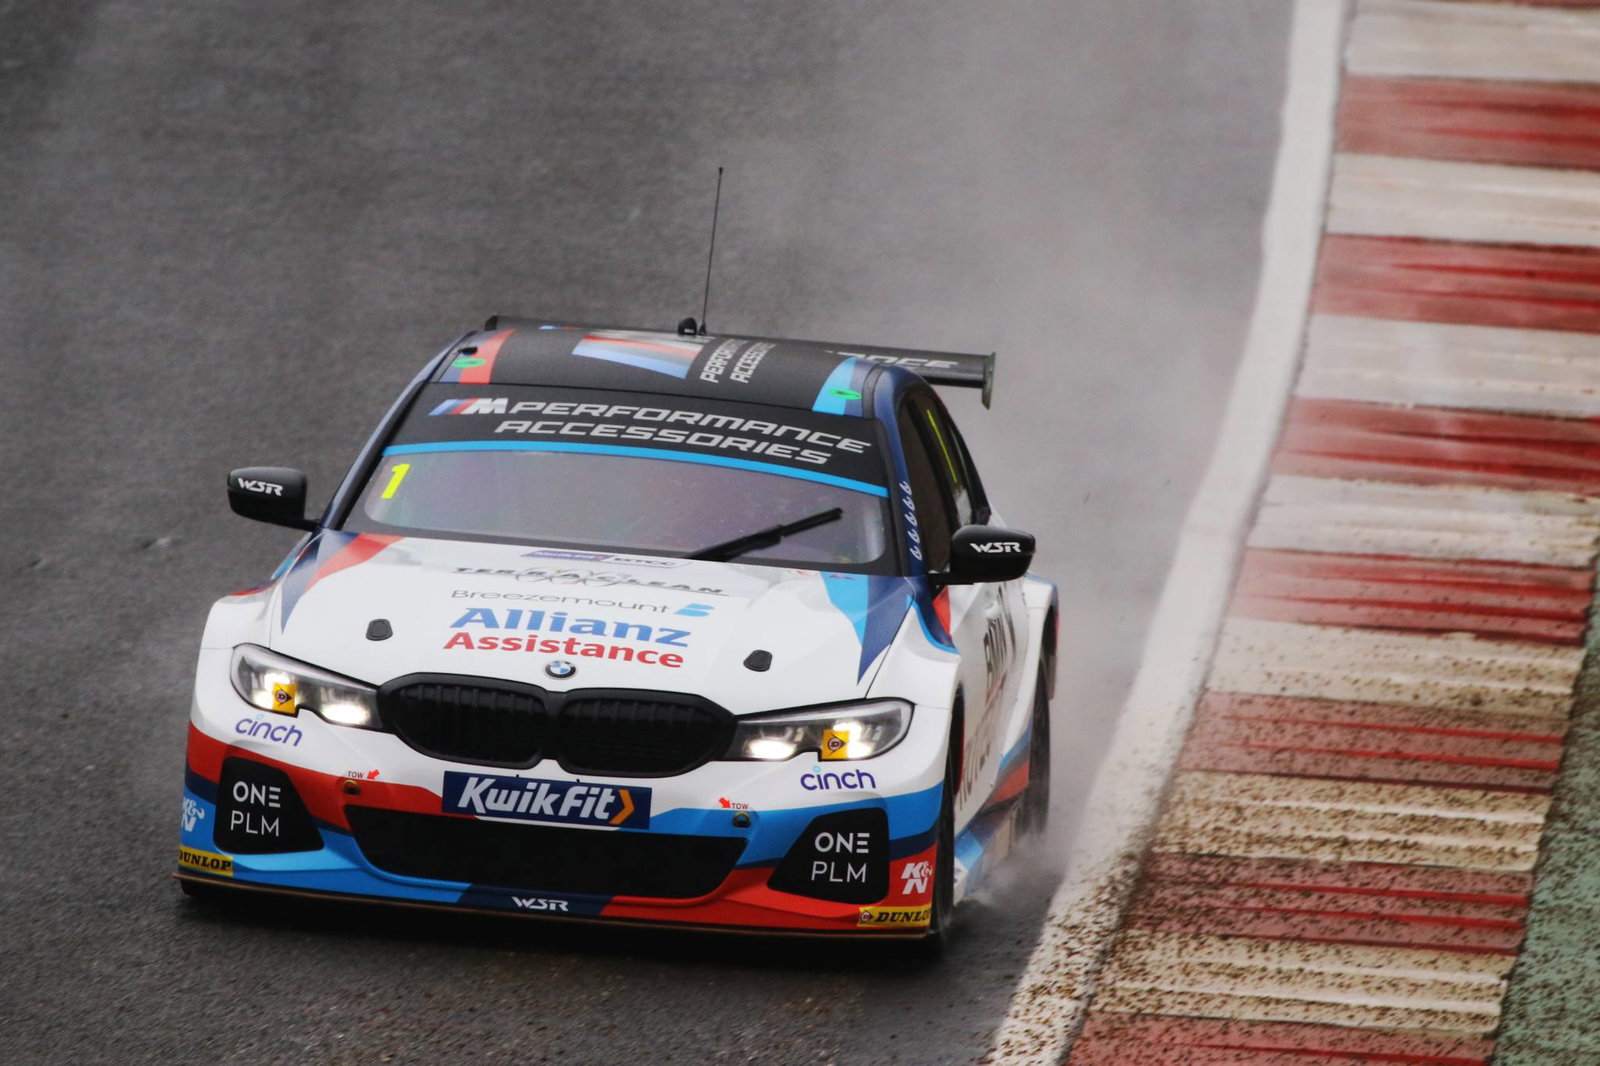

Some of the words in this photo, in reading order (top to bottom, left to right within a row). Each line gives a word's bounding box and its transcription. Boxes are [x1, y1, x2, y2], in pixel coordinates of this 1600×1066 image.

[509, 401, 872, 454] PERFORMANCE
[494, 420, 832, 465] ACCESSORIES
[238, 477, 284, 497] WSR
[381, 463, 411, 499] 1
[969, 541, 1022, 553] WSR
[451, 589, 671, 614] Breezemount
[449, 607, 692, 648] Allianz
[443, 631, 685, 669] Assistance
[235, 712, 303, 747] cinch
[347, 770, 365, 780] TOW
[800, 765, 876, 791] cinch
[232, 781, 281, 809] ONE
[731, 802, 749, 810] TOW
[230, 810, 280, 837] PLM
[814, 832, 870, 854] ONE
[811, 861, 867, 884] PLM
[511, 896, 569, 912] WSR
